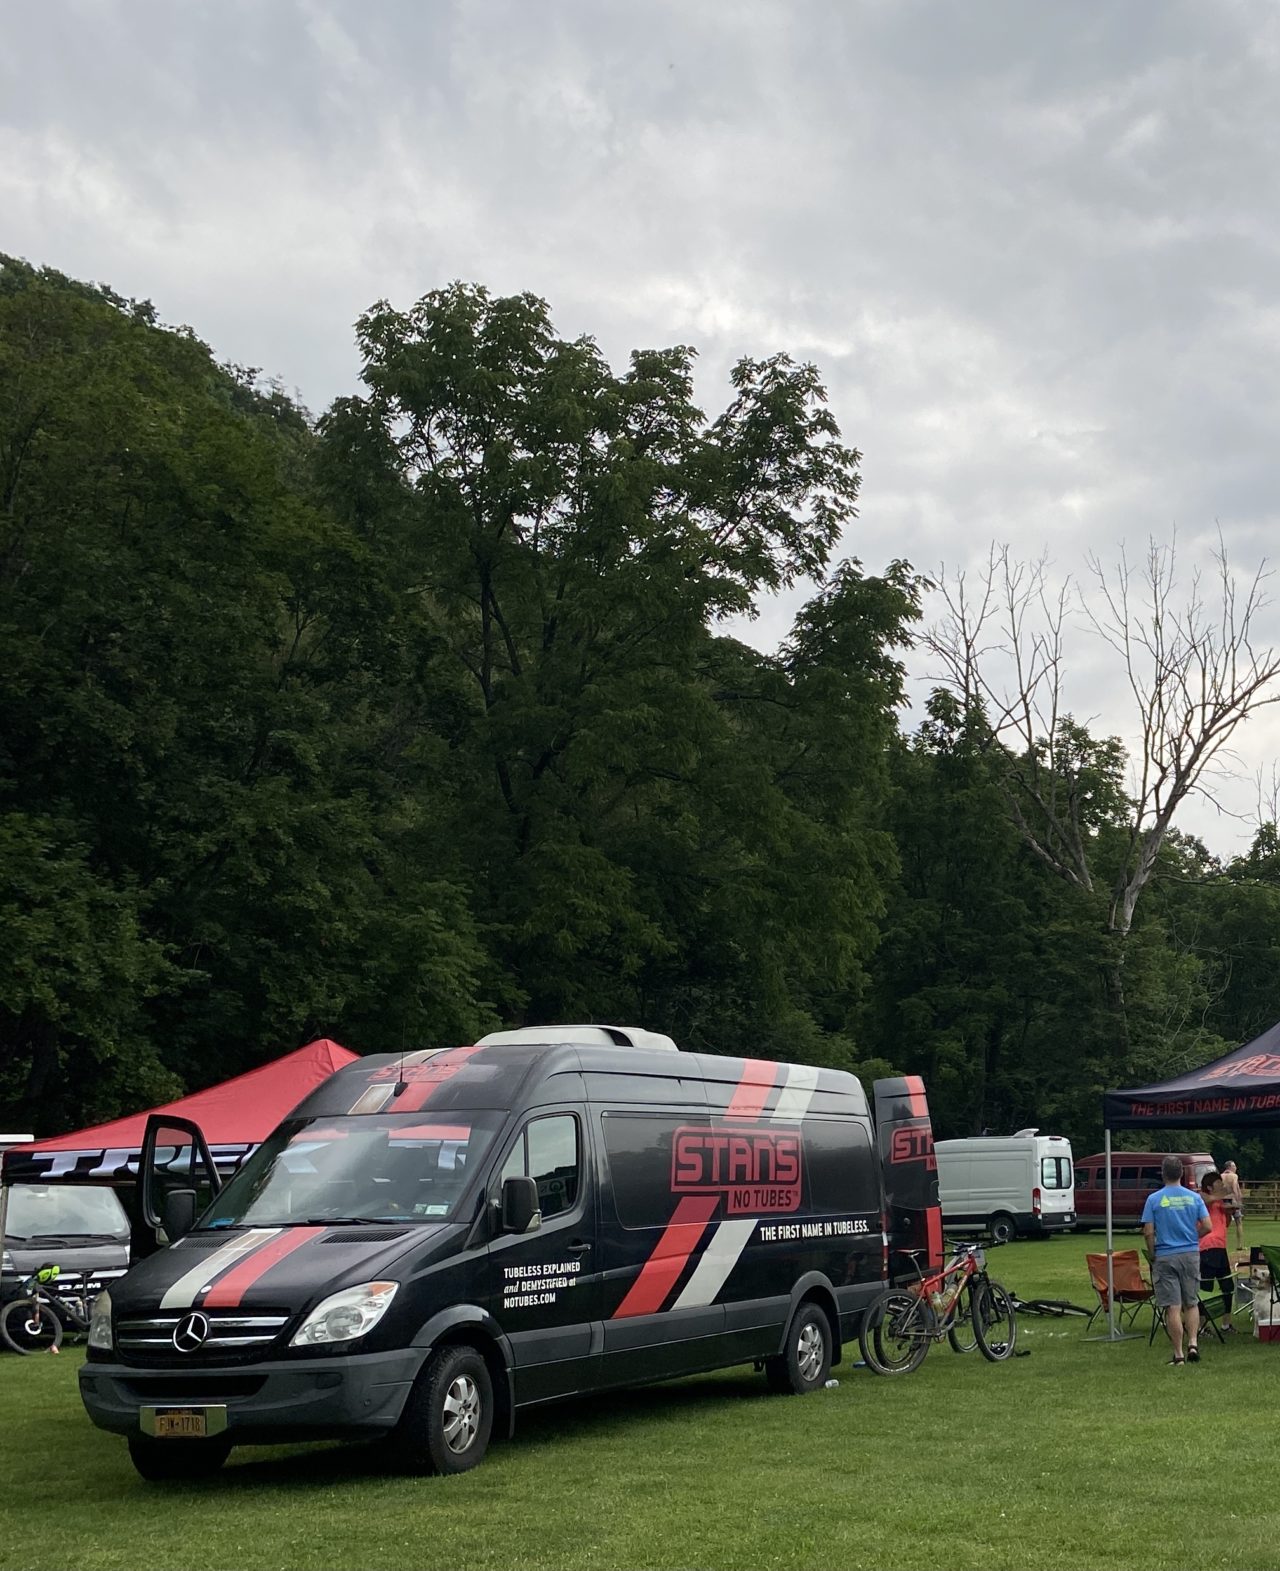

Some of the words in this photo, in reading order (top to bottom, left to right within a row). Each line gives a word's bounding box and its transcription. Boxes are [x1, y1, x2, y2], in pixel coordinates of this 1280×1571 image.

[1131, 1103, 1153, 1116] THE
[1156, 1101, 1190, 1115] FIRST
[1194, 1099, 1230, 1113] NAME
[1233, 1097, 1246, 1110] IN
[676, 1136, 799, 1182] STANS
[733, 1190, 751, 1209] NO
[753, 1189, 792, 1208] TUBES
[760, 1227, 777, 1241] THE
[778, 1224, 801, 1240] FIRST
[802, 1222, 823, 1238] NAME
[824, 1222, 832, 1236] IN
[833, 1219, 870, 1235] TUBELESS.
[504, 1265, 542, 1279] TUBELESS
[543, 1261, 581, 1275] EXPLAINED
[503, 1280, 519, 1294] and
[521, 1277, 568, 1292] DEMYSTIFIED
[568, 1276, 577, 1287] at
[503, 1292, 557, 1309] NOTUBES.COM
